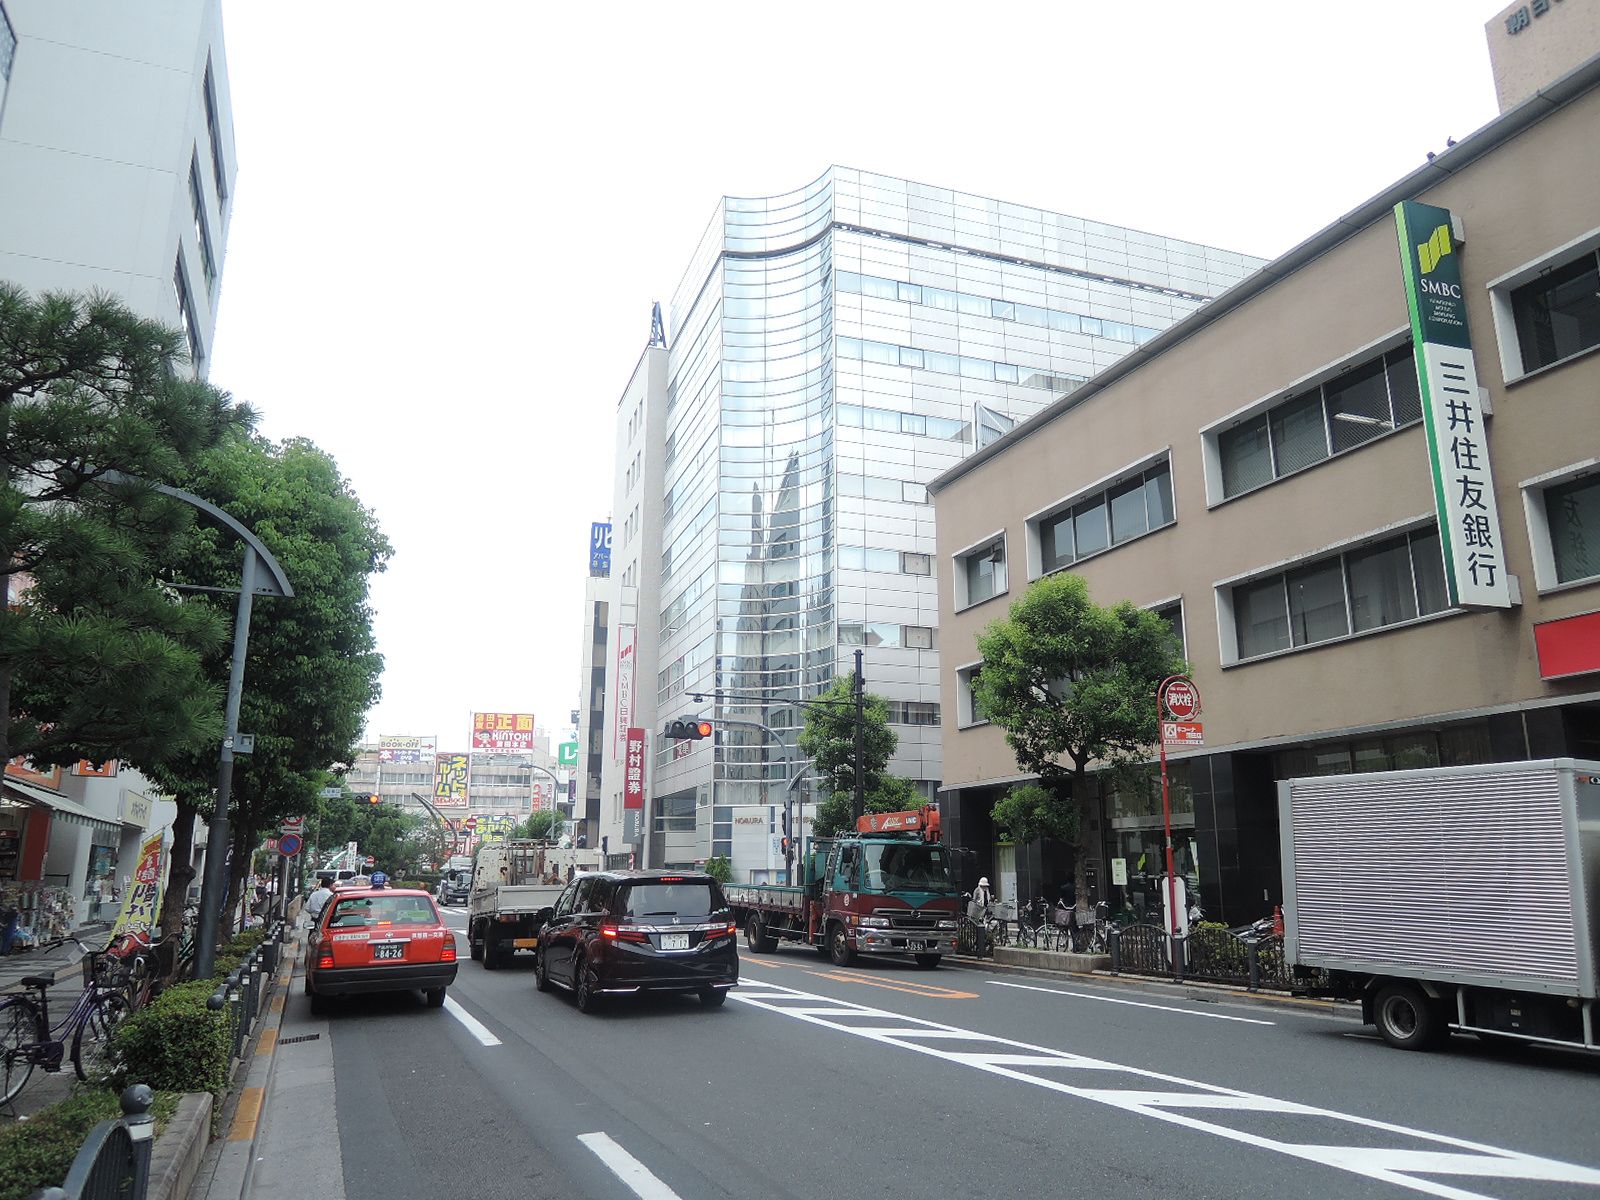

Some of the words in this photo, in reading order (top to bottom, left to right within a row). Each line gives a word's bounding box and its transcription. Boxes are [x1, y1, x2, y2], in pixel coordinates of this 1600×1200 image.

[1420, 278, 1461, 299] SMBC
[1440, 361, 1497, 587] 三井住友銀行
[496, 714, 533, 730] 正面
[627, 739, 642, 794] 野村證券
[633, 810, 641, 838] NOMURA
[734, 816, 764, 825] NOMURA
[380, 949, 402, 958] 84-26
